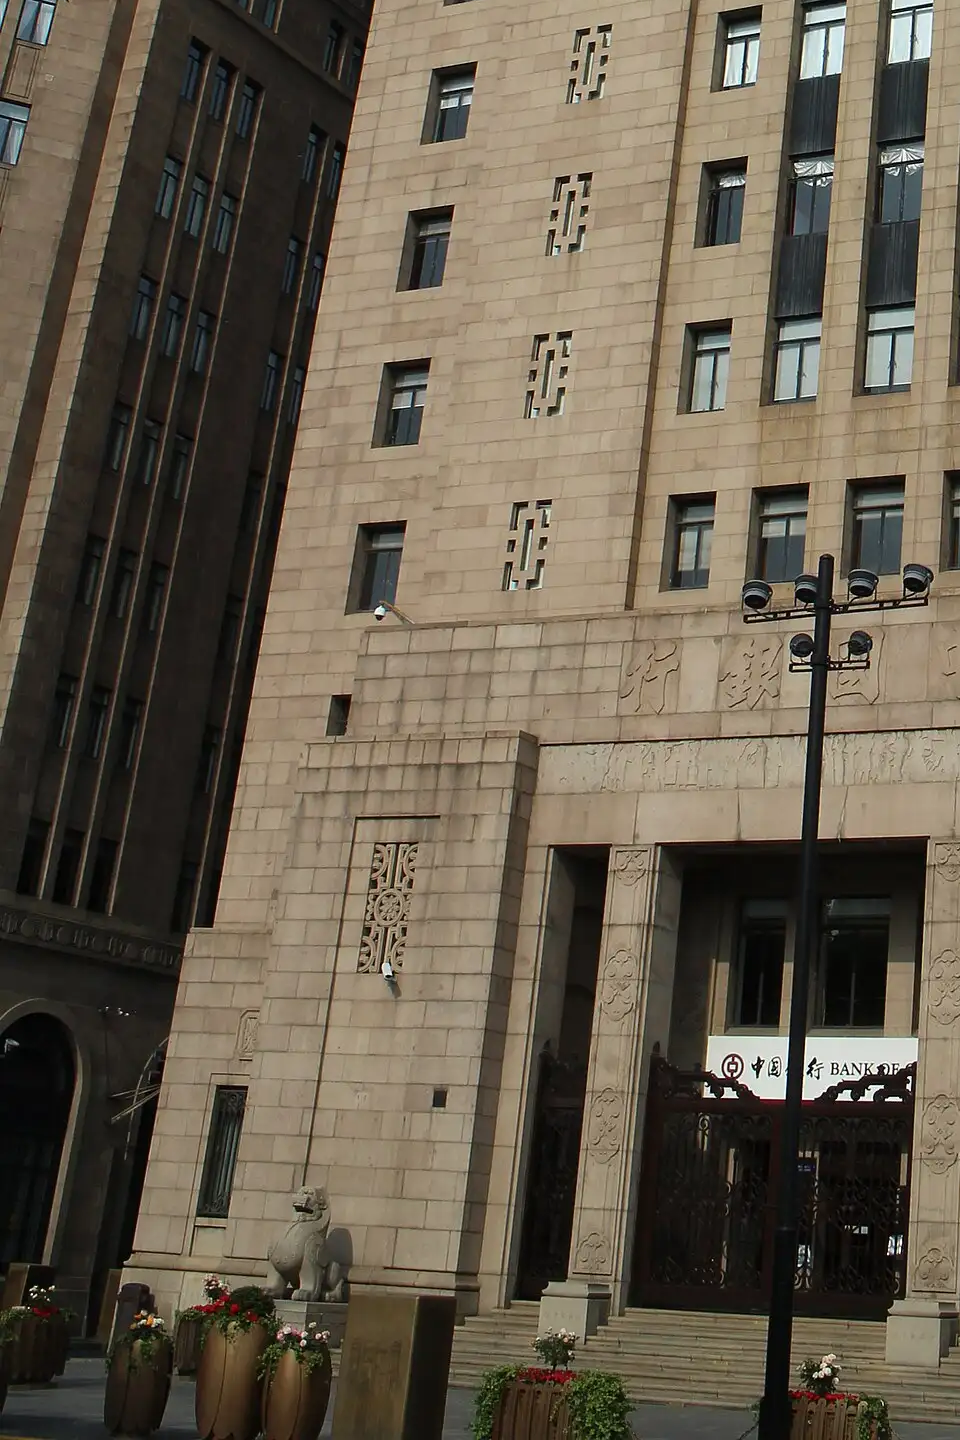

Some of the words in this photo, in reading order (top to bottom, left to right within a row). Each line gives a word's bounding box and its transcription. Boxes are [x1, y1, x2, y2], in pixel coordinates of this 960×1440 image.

[751, 1055, 825, 1080] 中国行
[830, 1061, 874, 1076] BANK
